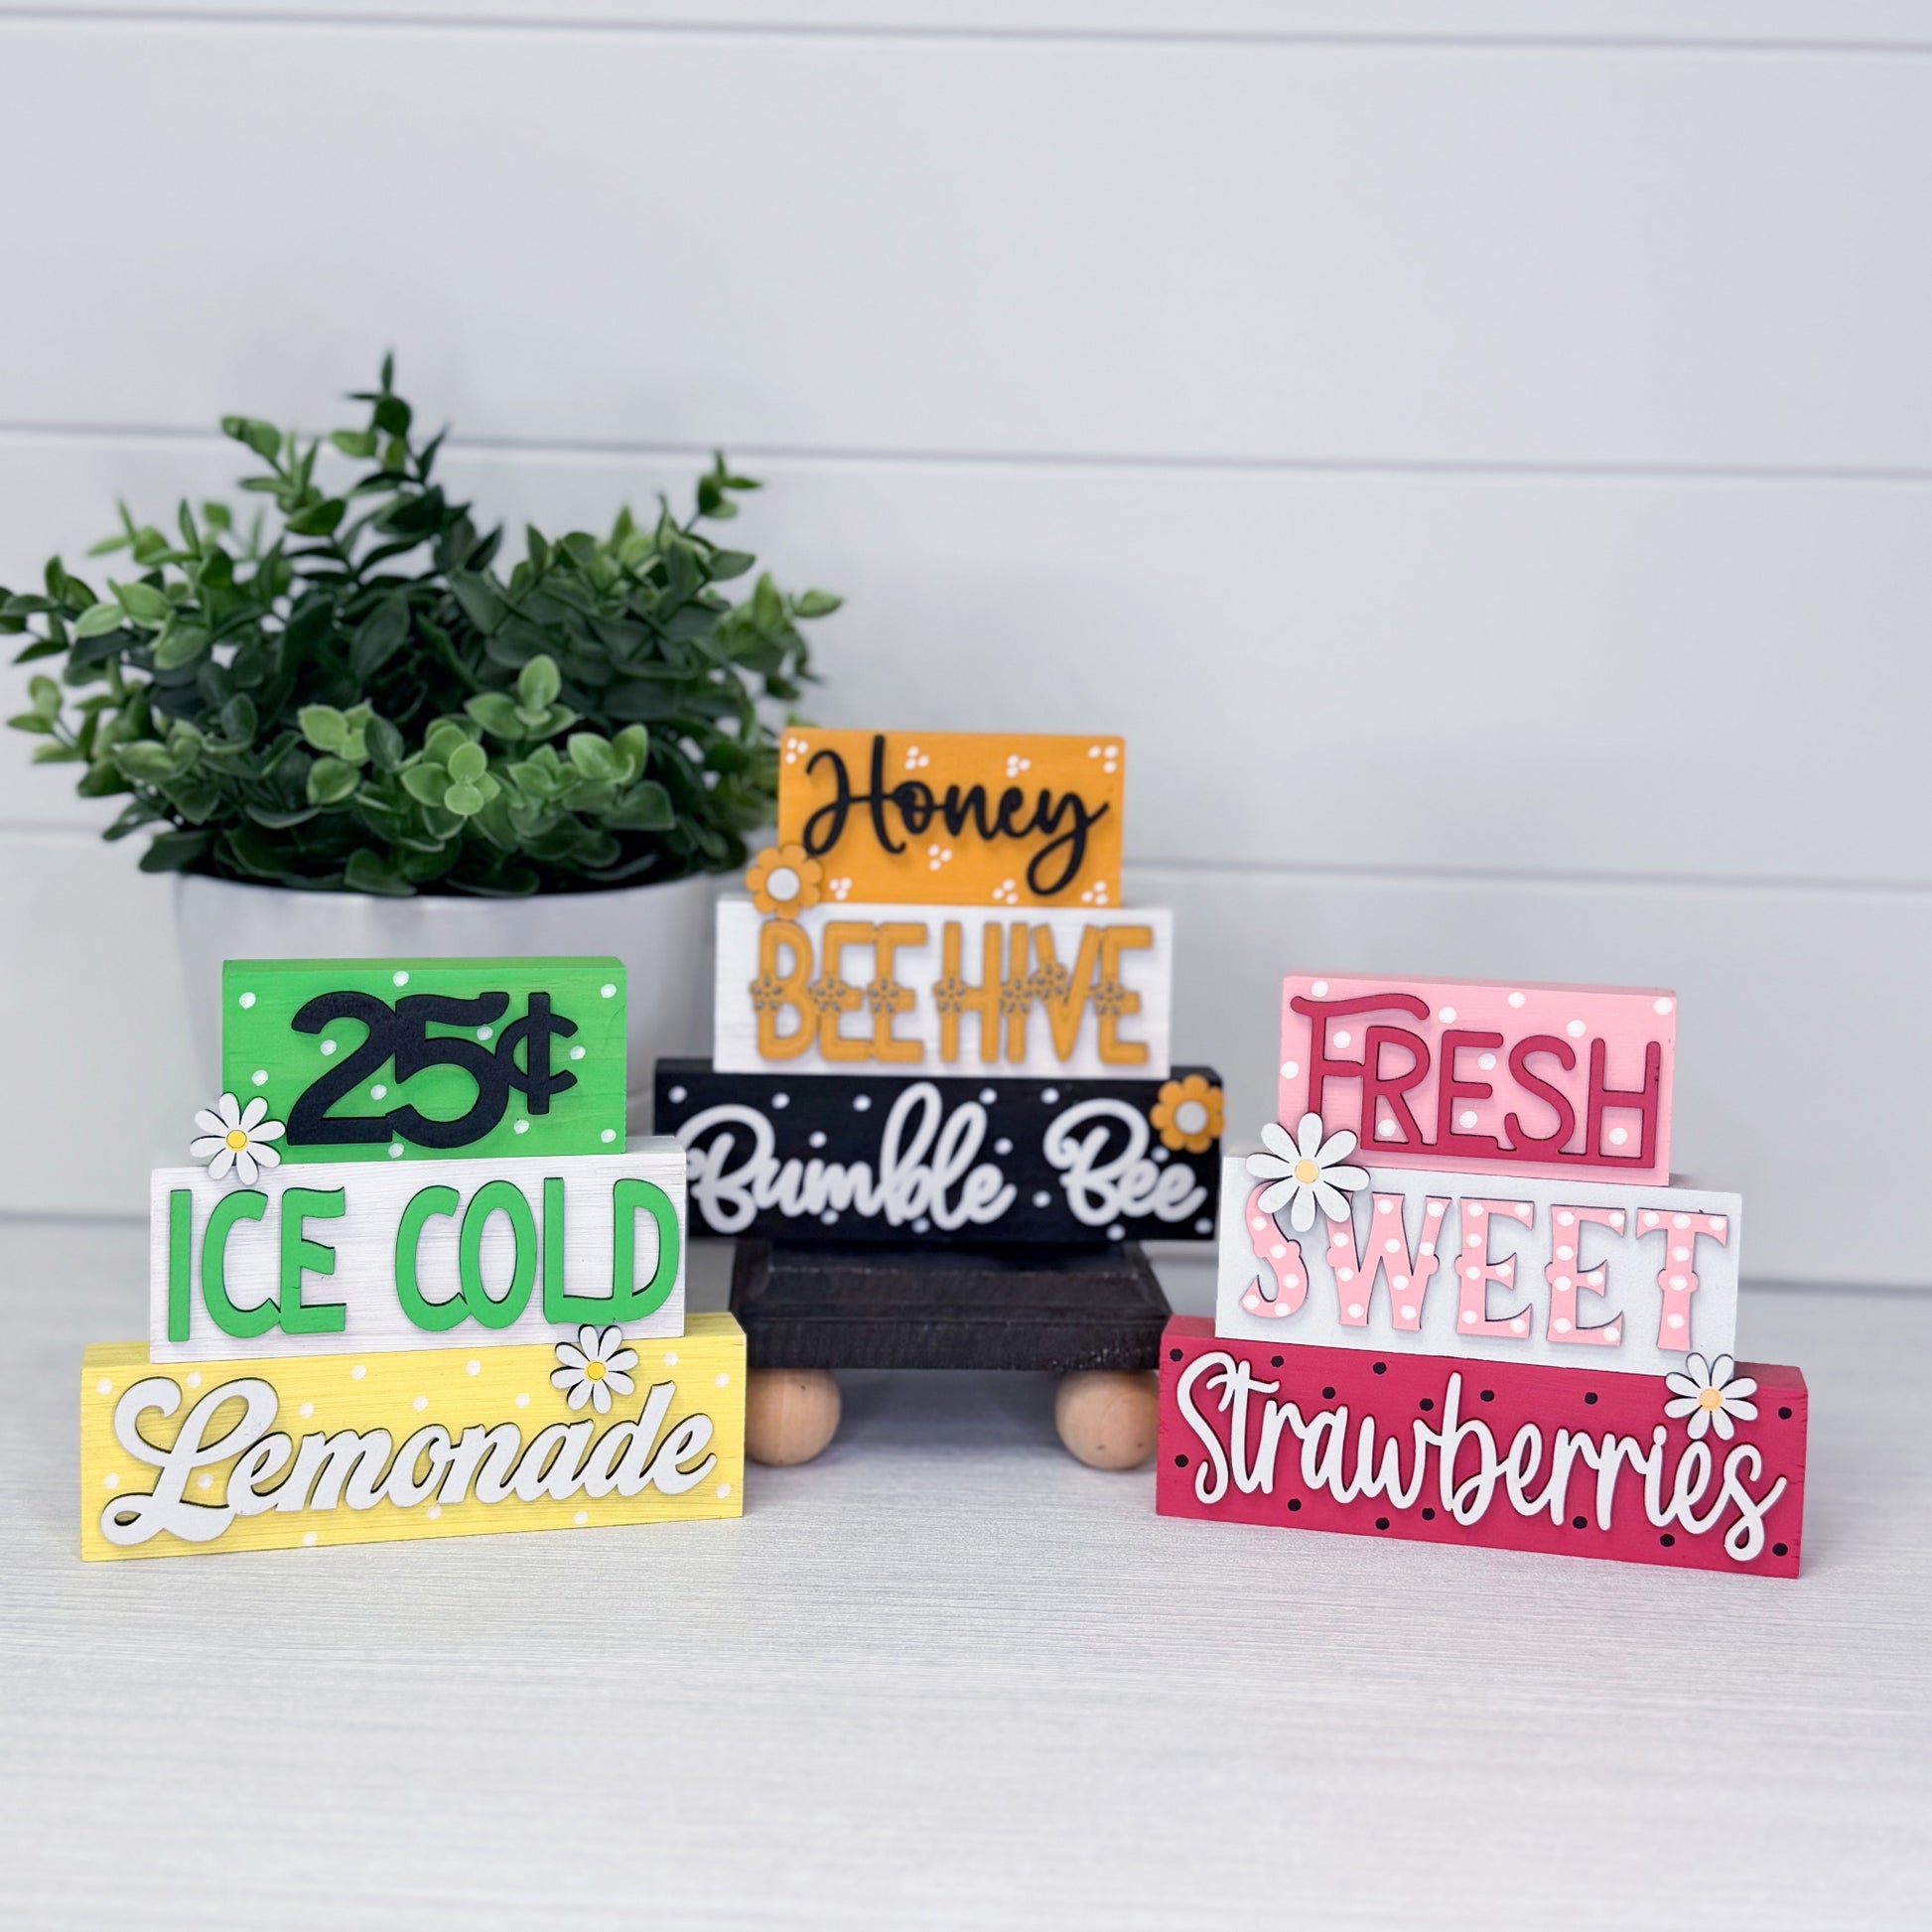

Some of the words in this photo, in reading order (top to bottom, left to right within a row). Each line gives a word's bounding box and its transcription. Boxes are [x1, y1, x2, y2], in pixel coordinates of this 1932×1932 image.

[802, 735, 1109, 896] Honey
[286, 990, 578, 1149] 25¢
[1291, 993, 1661, 1169] FRESH
[676, 1082, 1017, 1233] Bumble
[1043, 1098, 1207, 1226] Bee
[168, 1187, 346, 1342] ICE
[395, 1177, 679, 1331] COLD
[1239, 1180, 1728, 1351] SWEET
[100, 1376, 717, 1545] Lemonade
[1177, 1351, 1786, 1562] Strawberries
